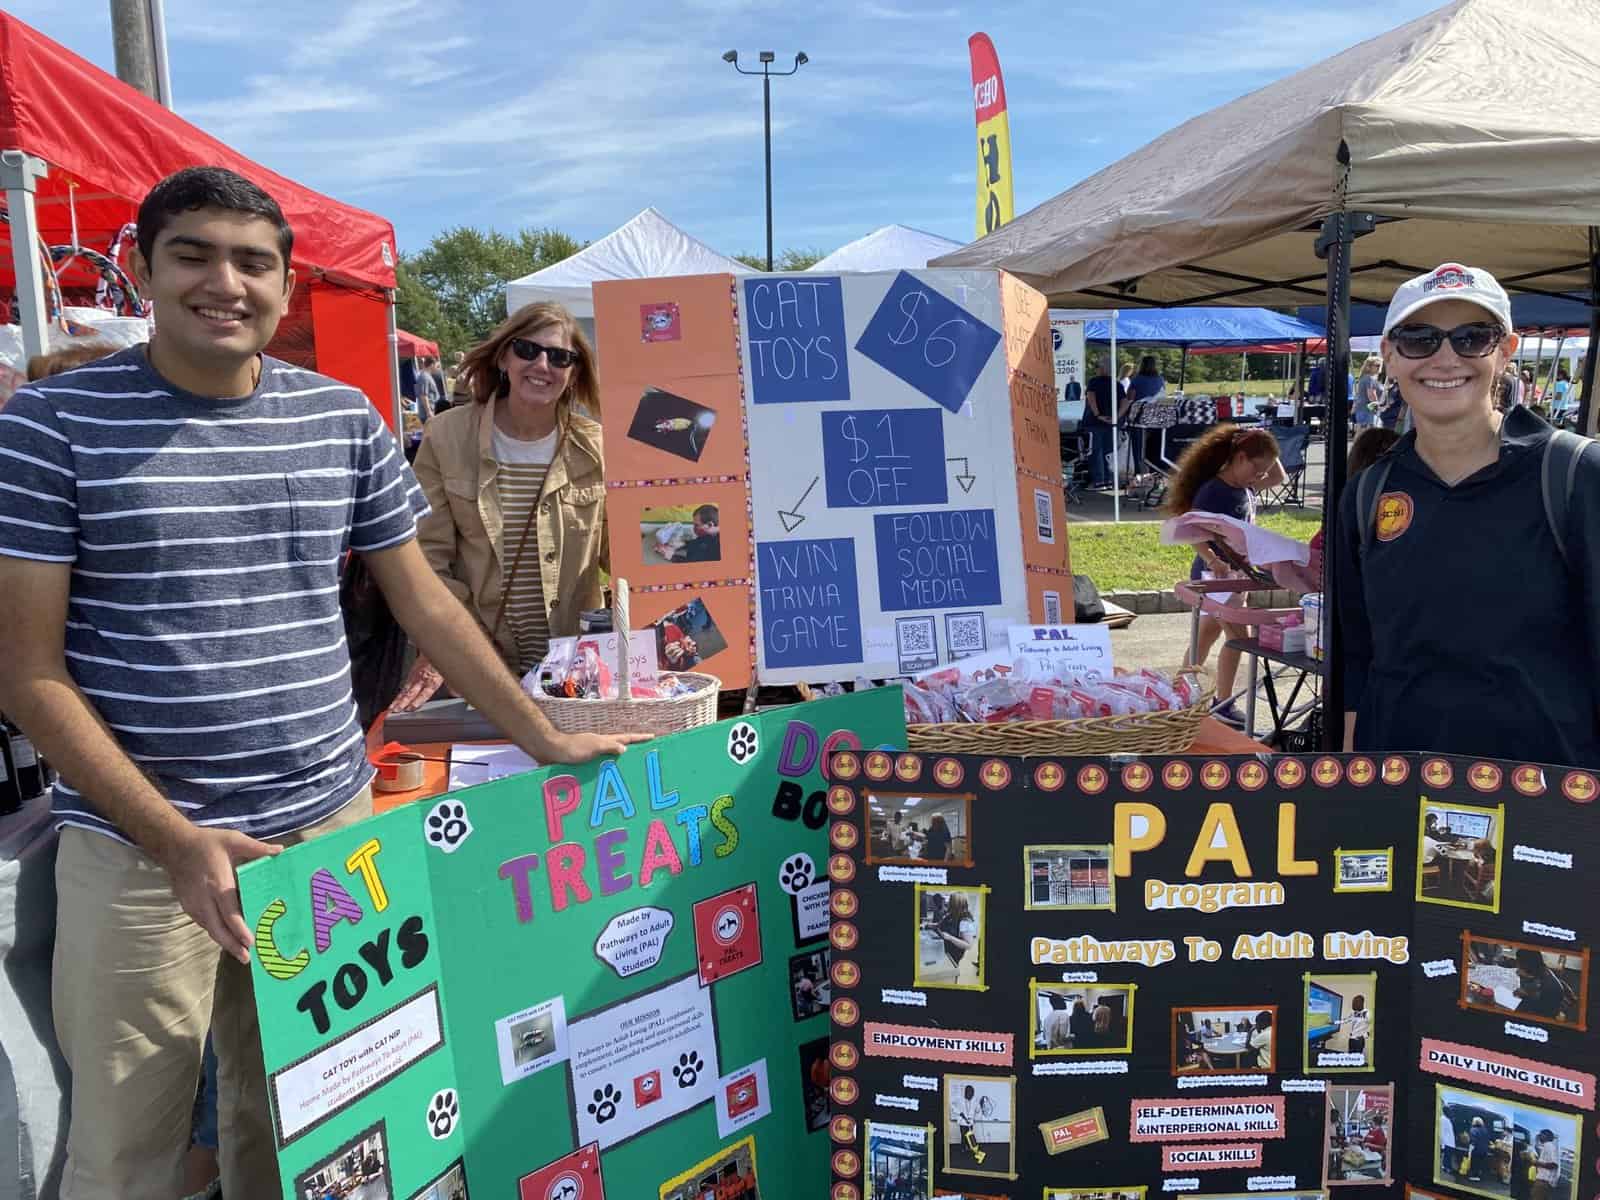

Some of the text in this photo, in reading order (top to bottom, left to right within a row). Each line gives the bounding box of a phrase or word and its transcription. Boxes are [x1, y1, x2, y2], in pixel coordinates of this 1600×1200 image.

[753, 280, 831, 329] CAT
[887, 290, 968, 368] $6
[750, 336, 839, 380] TOYS
[841, 414, 911, 463] $1
[848, 466, 913, 505] OFF
[893, 511, 989, 544] FOLLOW
[769, 542, 838, 580] WIN
[897, 543, 987, 578] SOCIAL
[763, 584, 841, 611] TRIVIA
[901, 578, 968, 606] MEDIA
[770, 615, 849, 653] GAME
[1032, 628, 1076, 641] PAL
[542, 749, 680, 842] PAL
[1114, 802, 1319, 877] PAL
[498, 795, 739, 924] TREATS
[255, 838, 389, 980] CAT
[1145, 879, 1284, 912] Program
[600, 919, 671, 951] Pathways to Adult
[617, 911, 652, 929] Made by
[615, 937, 660, 961] Living (PAL)
[622, 956, 657, 974] Students
[1033, 932, 1409, 966] Pathways To Adult Living
[296, 916, 429, 1034] TOYS
[322, 1029, 401, 1080] CAT TOYS with CAT NIP
[873, 1033, 1006, 1053] EMPLOYMENT SKILLS
[1428, 1050, 1581, 1094] DAILY LIVING SKILLS
[1137, 1104, 1274, 1118] SELF-DETERMINATION
[1137, 1120, 1279, 1134] &INTERPERSONAL SKILLS
[1053, 1127, 1071, 1140] PAL
[1171, 1149, 1257, 1164] SOCIAL SKILLS
